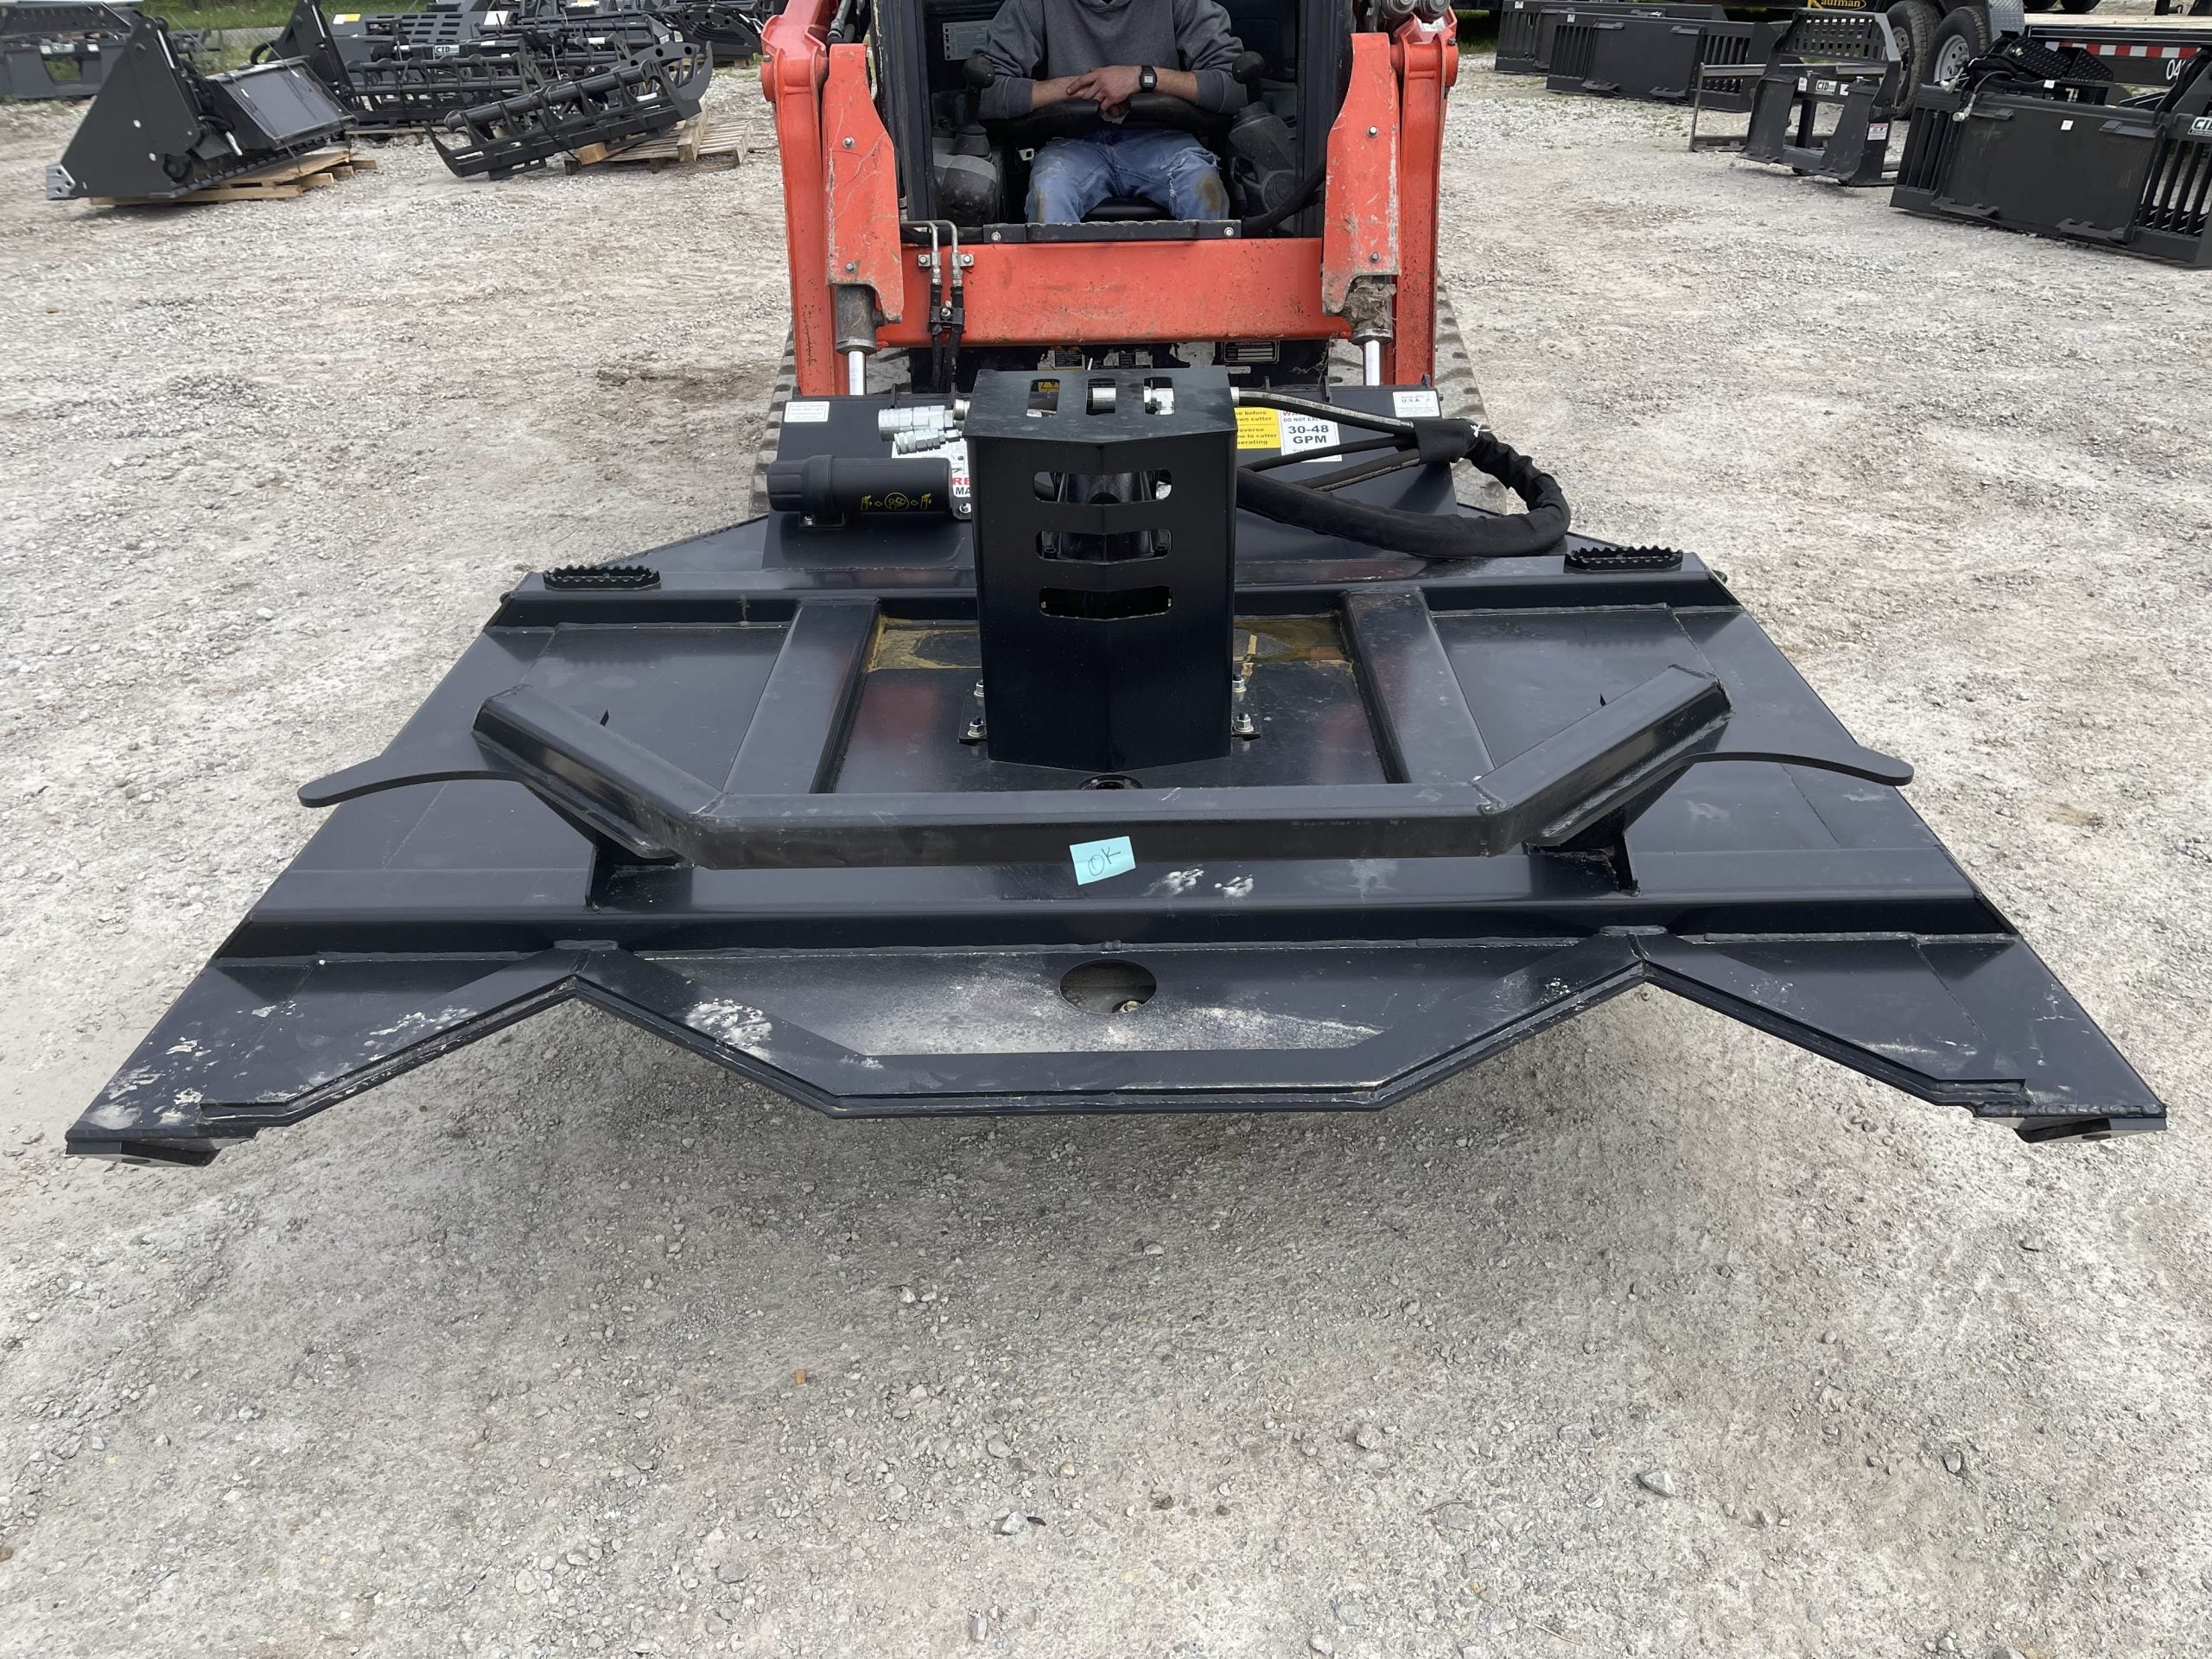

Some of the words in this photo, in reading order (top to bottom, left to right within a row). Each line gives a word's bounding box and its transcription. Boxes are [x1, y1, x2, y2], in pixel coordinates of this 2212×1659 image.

[1817, 81, 1830, 91] CID
[1287, 424, 1329, 434] 30-48
[1293, 435, 1326, 444] GPM
[1088, 847, 1122, 876] OK
